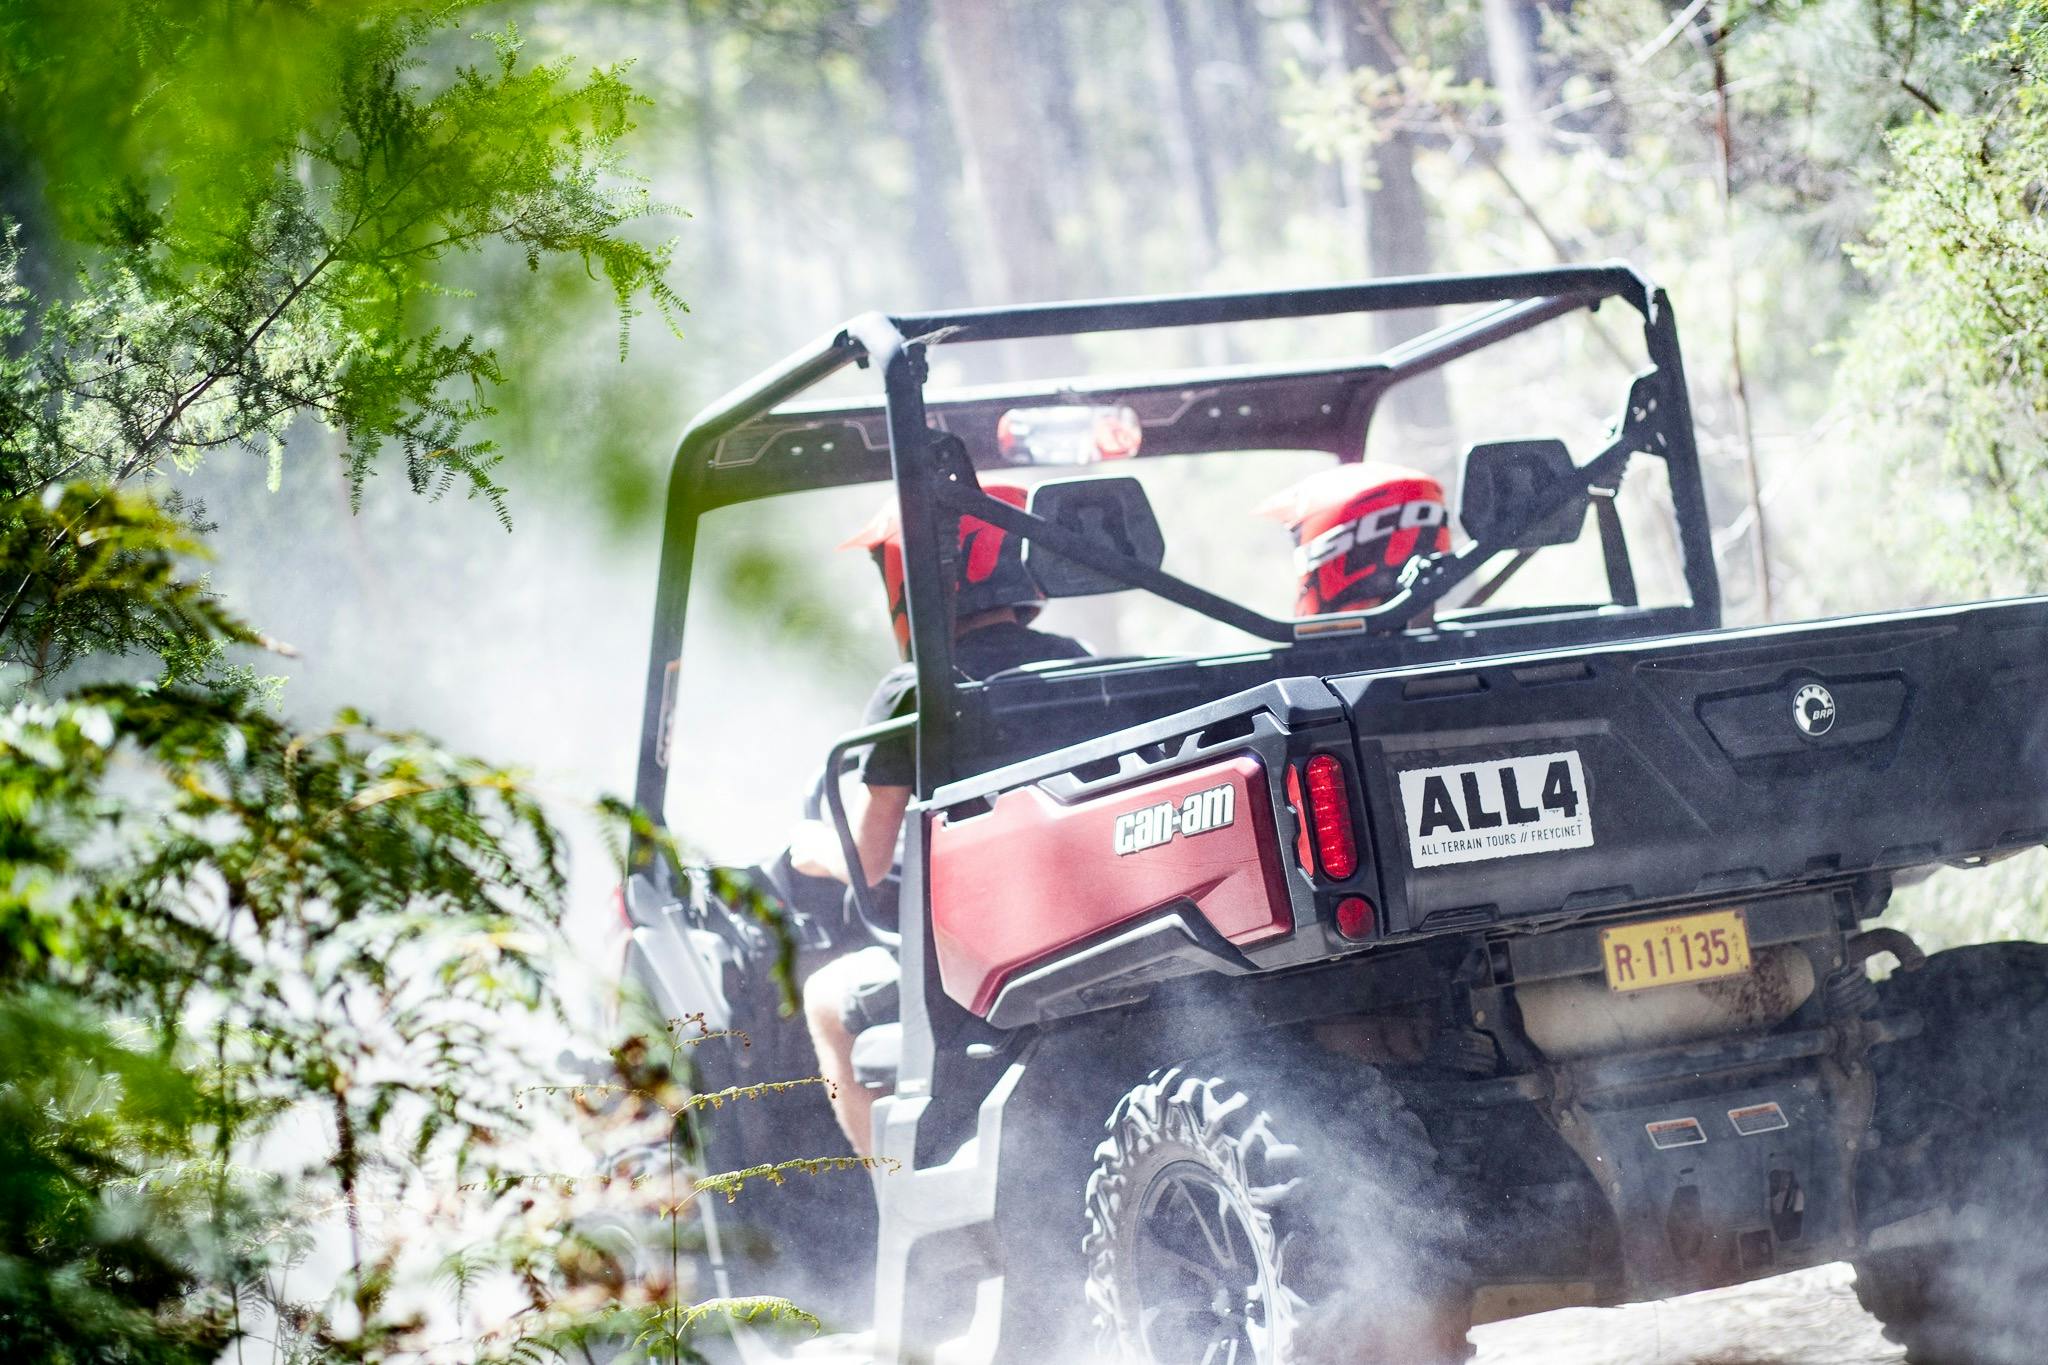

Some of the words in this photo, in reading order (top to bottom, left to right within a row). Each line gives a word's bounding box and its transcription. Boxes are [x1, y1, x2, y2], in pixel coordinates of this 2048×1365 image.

[1812, 708, 1833, 720] BRP
[1419, 760, 1578, 837] ALL4
[1421, 844, 1439, 856] ALL
[1442, 839, 1483, 853] TERRAIN
[1486, 833, 1517, 847] TOURS
[1531, 824, 1583, 841] FREYCINET
